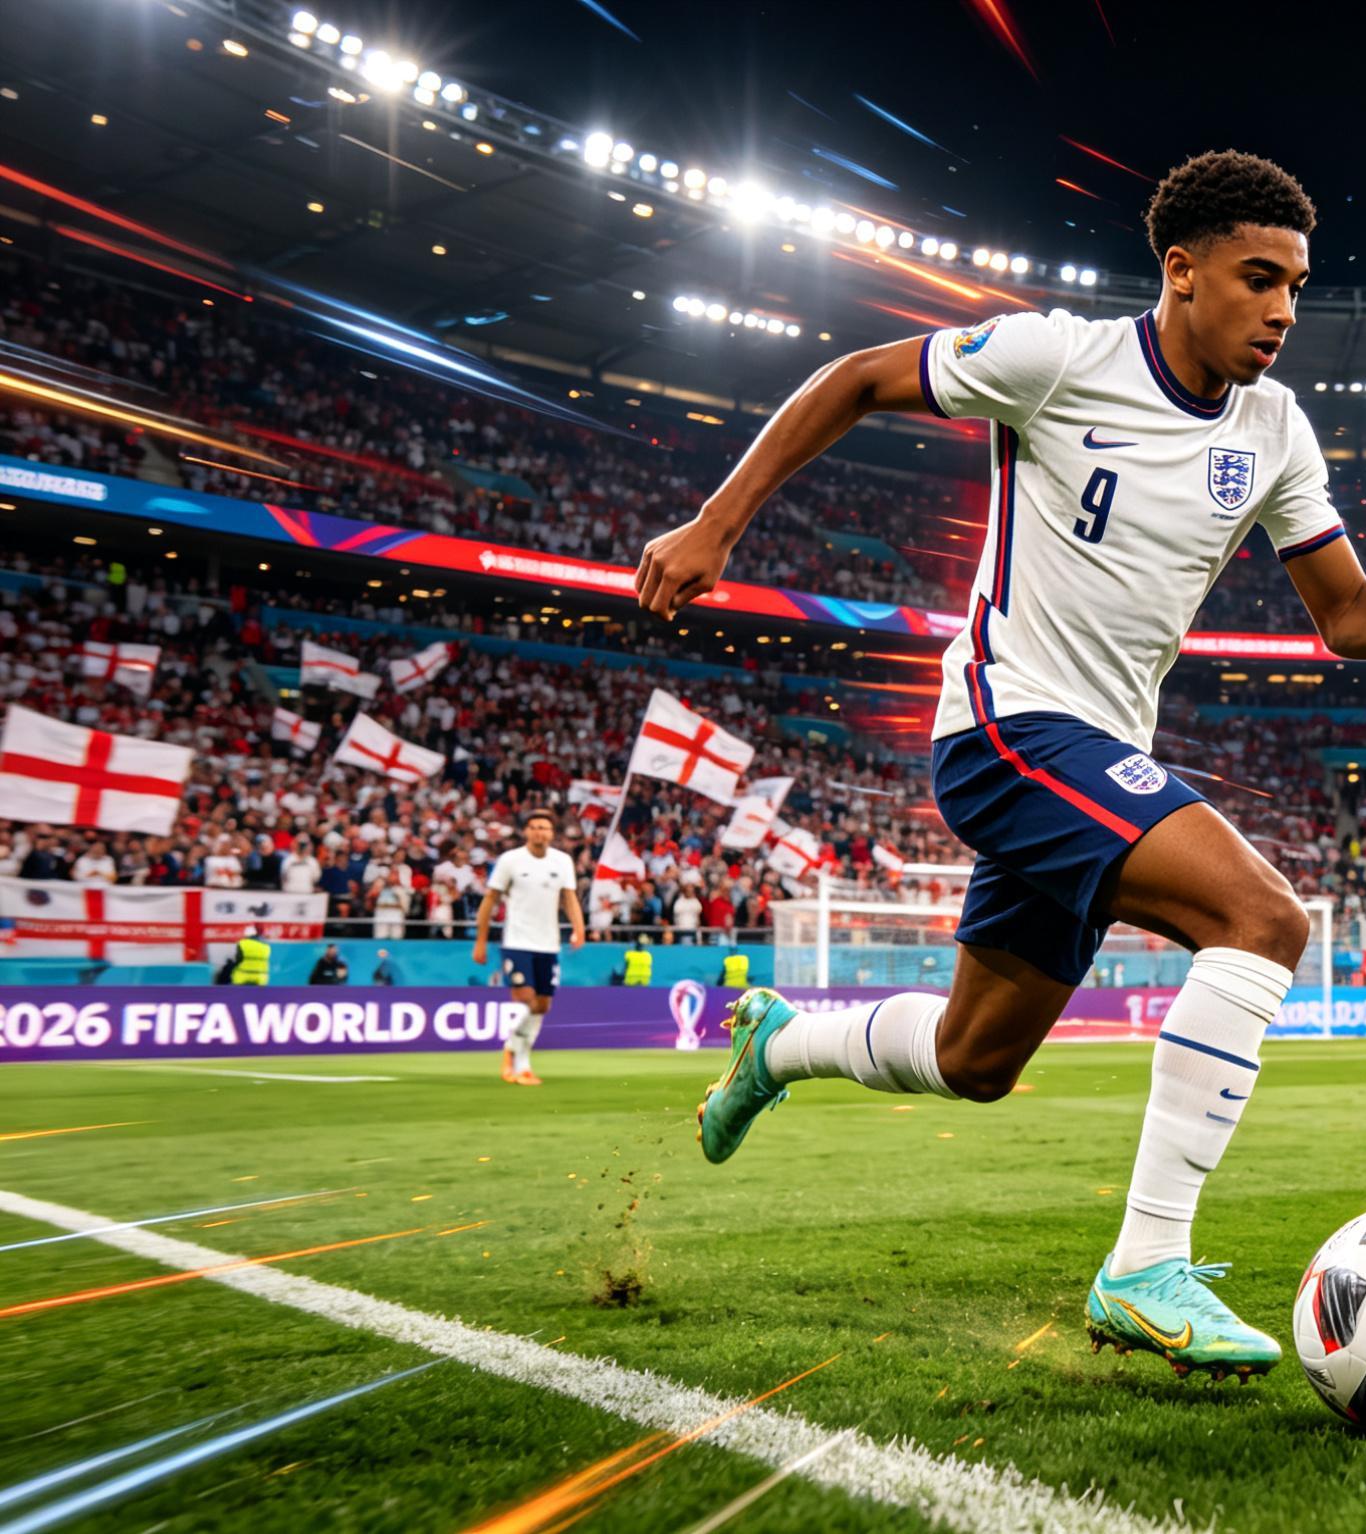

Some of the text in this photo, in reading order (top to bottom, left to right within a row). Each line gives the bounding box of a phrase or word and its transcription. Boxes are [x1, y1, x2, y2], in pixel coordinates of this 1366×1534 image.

[1073, 467, 1118, 544] 9
[0, 1001, 530, 1047] 026 FIFA WORLD CUP
